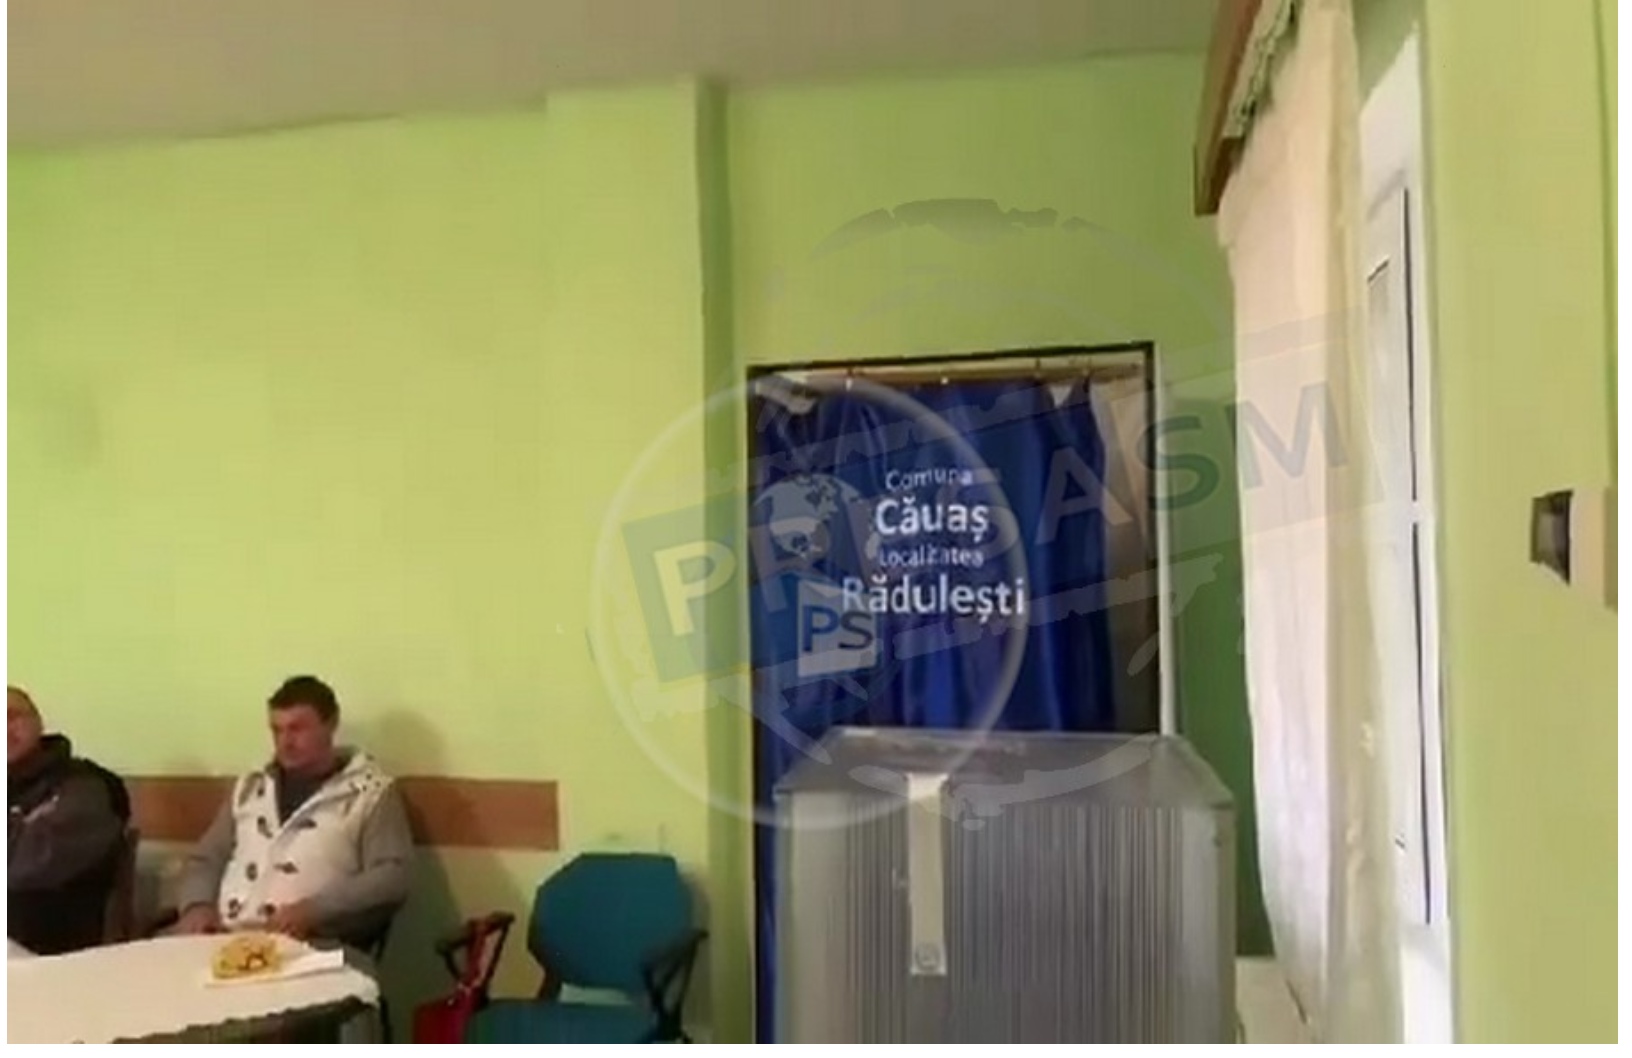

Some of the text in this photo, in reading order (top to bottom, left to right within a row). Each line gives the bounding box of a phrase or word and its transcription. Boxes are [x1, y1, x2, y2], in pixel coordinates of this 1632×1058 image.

[884, 467, 973, 492] Comuna
[875, 495, 990, 543] Căuaș
[879, 543, 984, 568] Localitatea
[842, 573, 1026, 624] Rădulești
